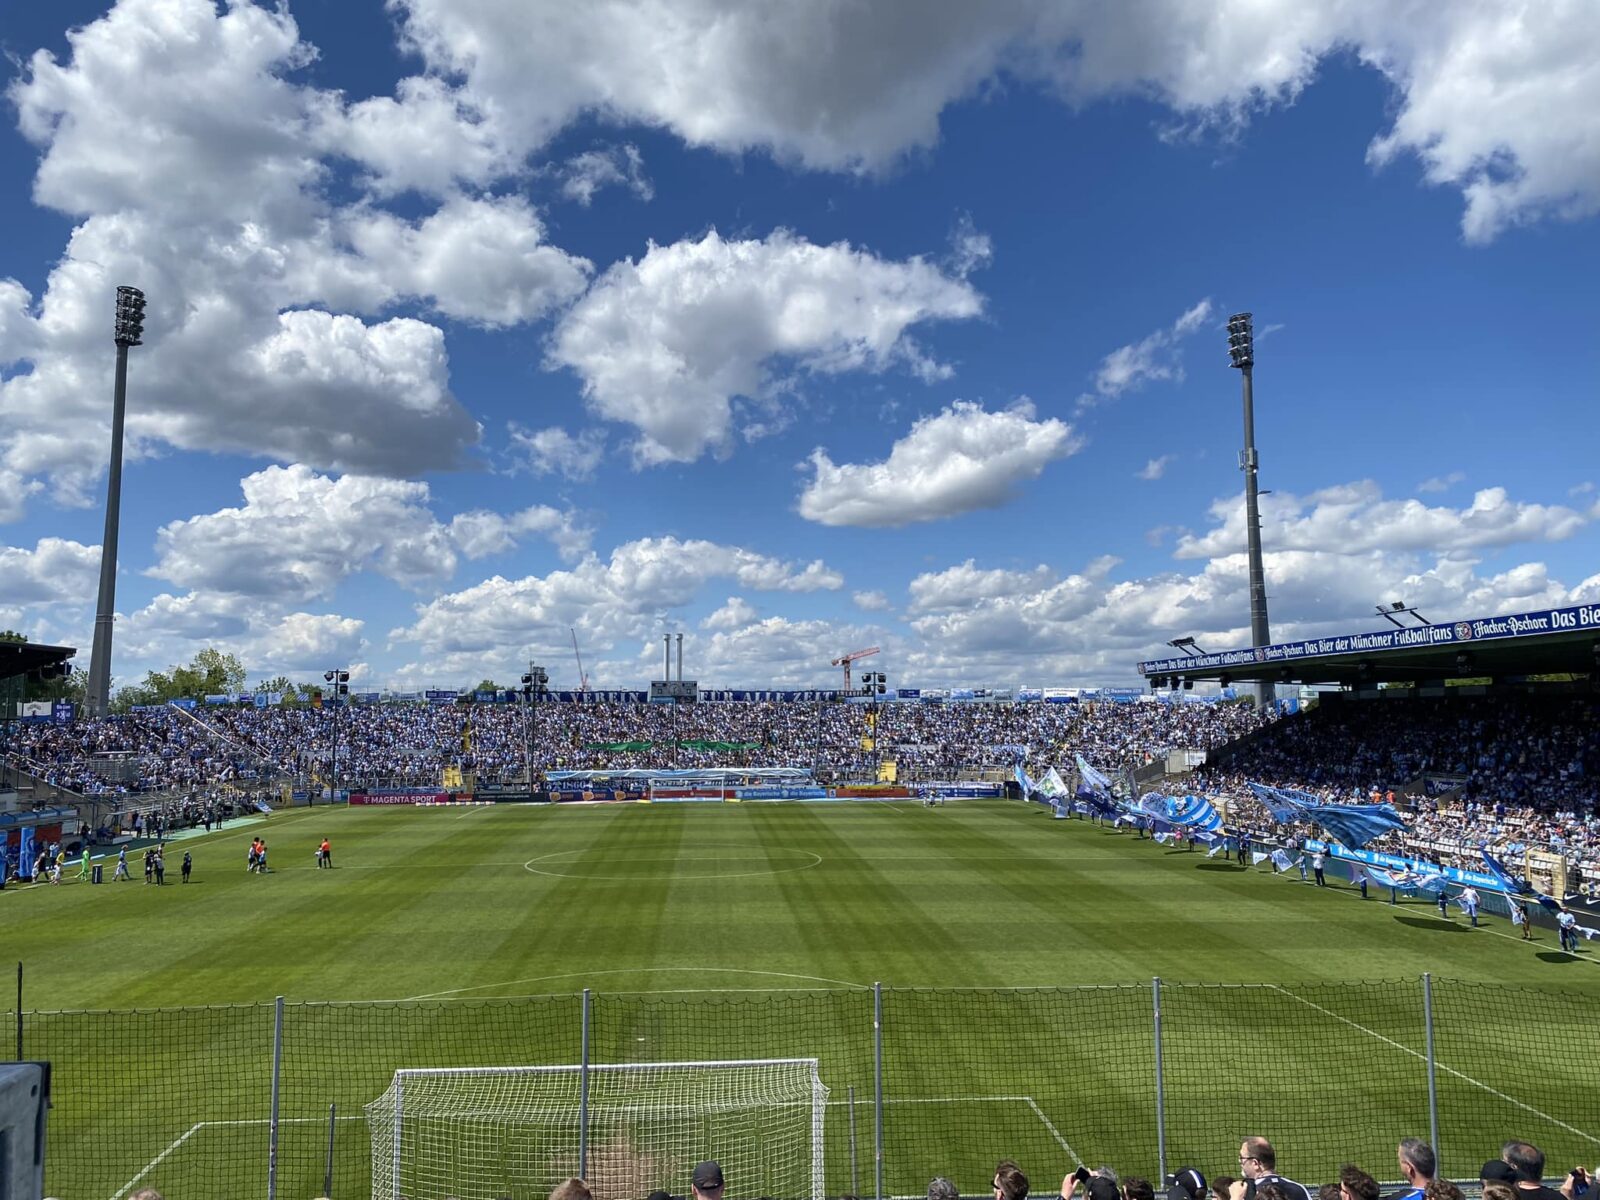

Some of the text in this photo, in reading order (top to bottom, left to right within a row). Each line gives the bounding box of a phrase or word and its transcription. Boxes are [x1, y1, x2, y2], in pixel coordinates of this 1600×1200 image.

[1473, 606, 1600, 637] Hacker-Pschorr Das Bie
[1264, 627, 1453, 660] Hacker-Pschorr Das Bier der Münchner Fußballfans
[1168, 660, 1177, 669] Das
[1177, 659, 1187, 668] Bier
[1187, 658, 1196, 667] der
[1196, 655, 1220, 666] Münchner
[1221, 651, 1255, 664] Fußballfans
[513, 691, 641, 703] MEIN VEREIN
[700, 690, 733, 702] FÜR
[743, 691, 786, 702] ALLE
[793, 691, 833, 703] ZEIT
[371, 796, 410, 804] MAGENTA
[411, 795, 436, 803] SPORT
[1299, 793, 1317, 803] DER
[1473, 874, 1498, 886] Bayerische
